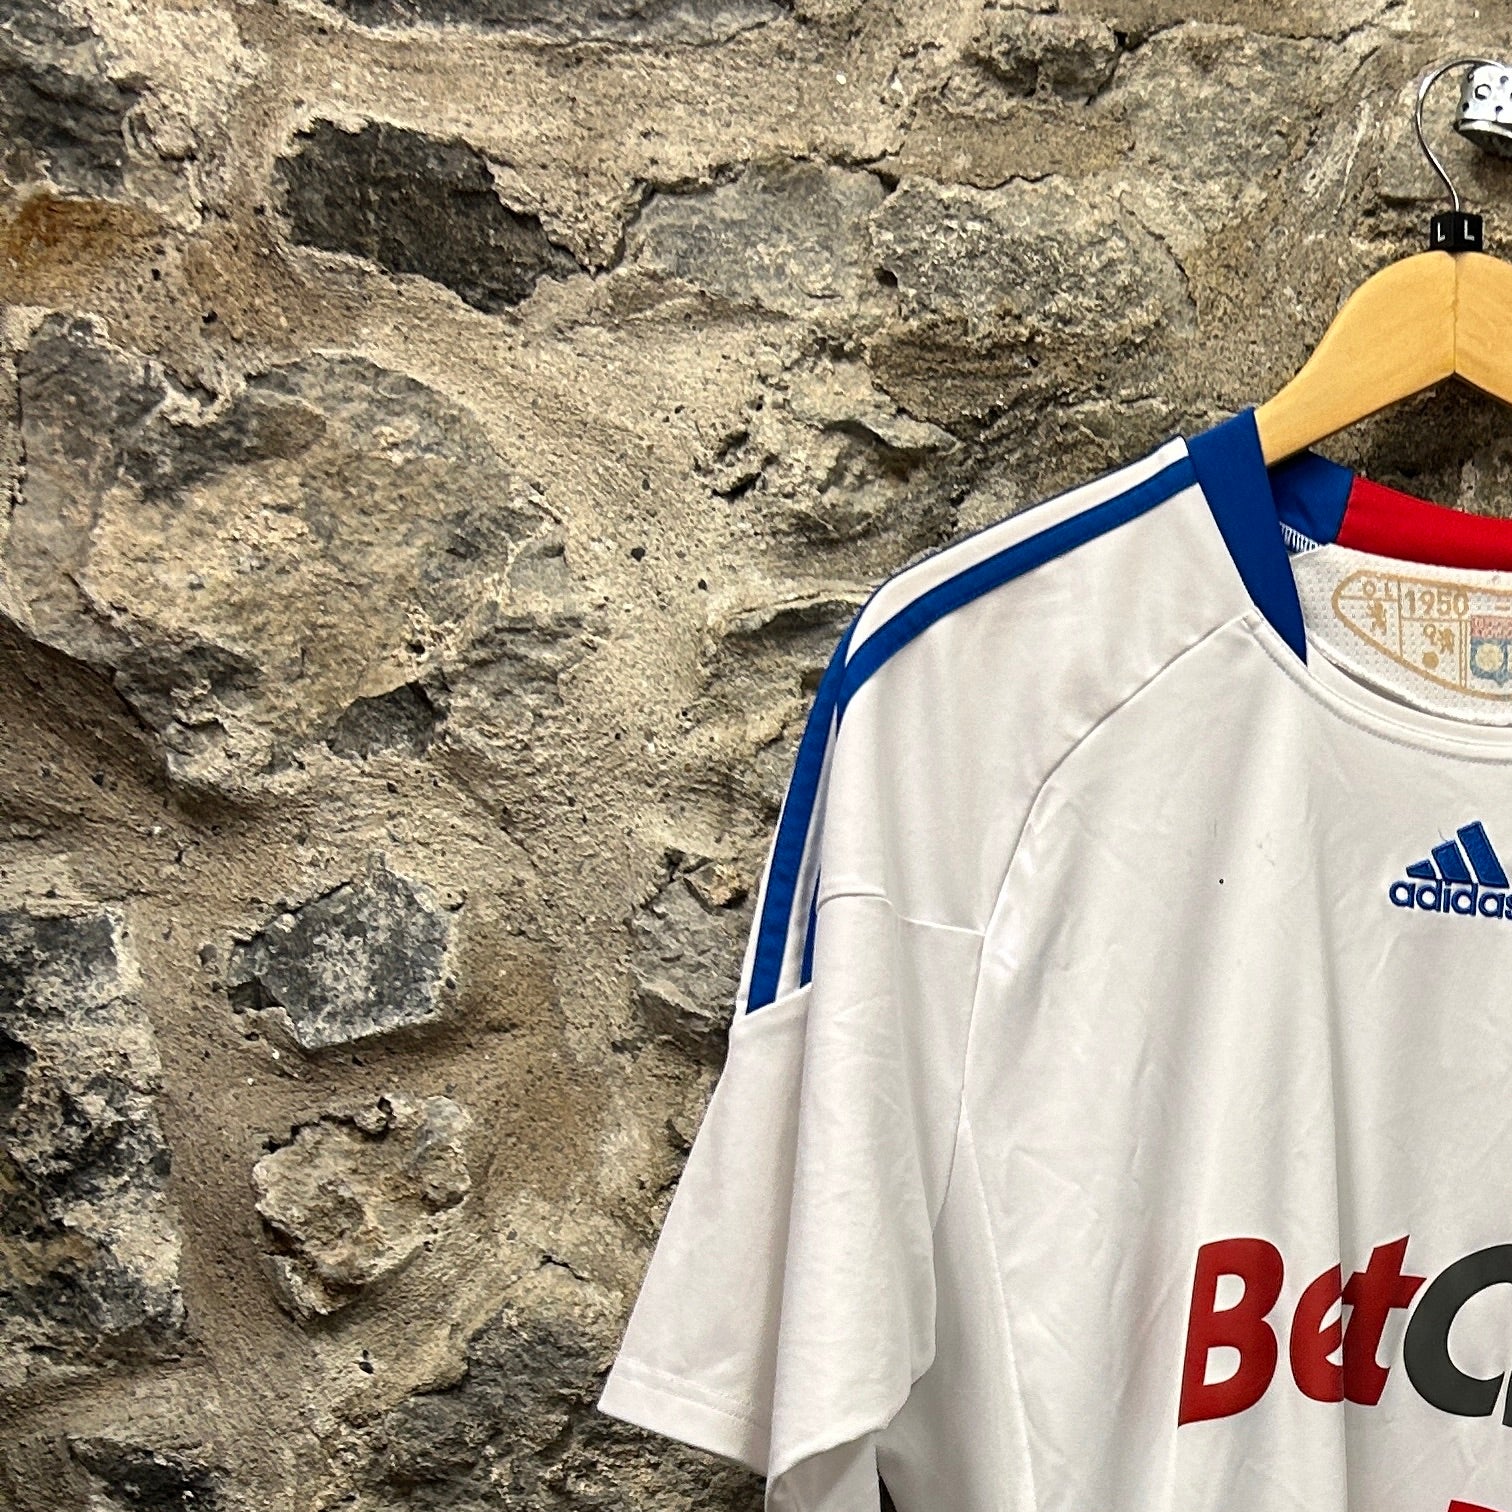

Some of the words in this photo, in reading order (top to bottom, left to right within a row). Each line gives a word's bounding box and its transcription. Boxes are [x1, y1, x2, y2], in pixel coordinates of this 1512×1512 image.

[1437, 222, 1446, 242] L
[1464, 219, 1475, 241] L
[1404, 588, 1470, 616] 1950
